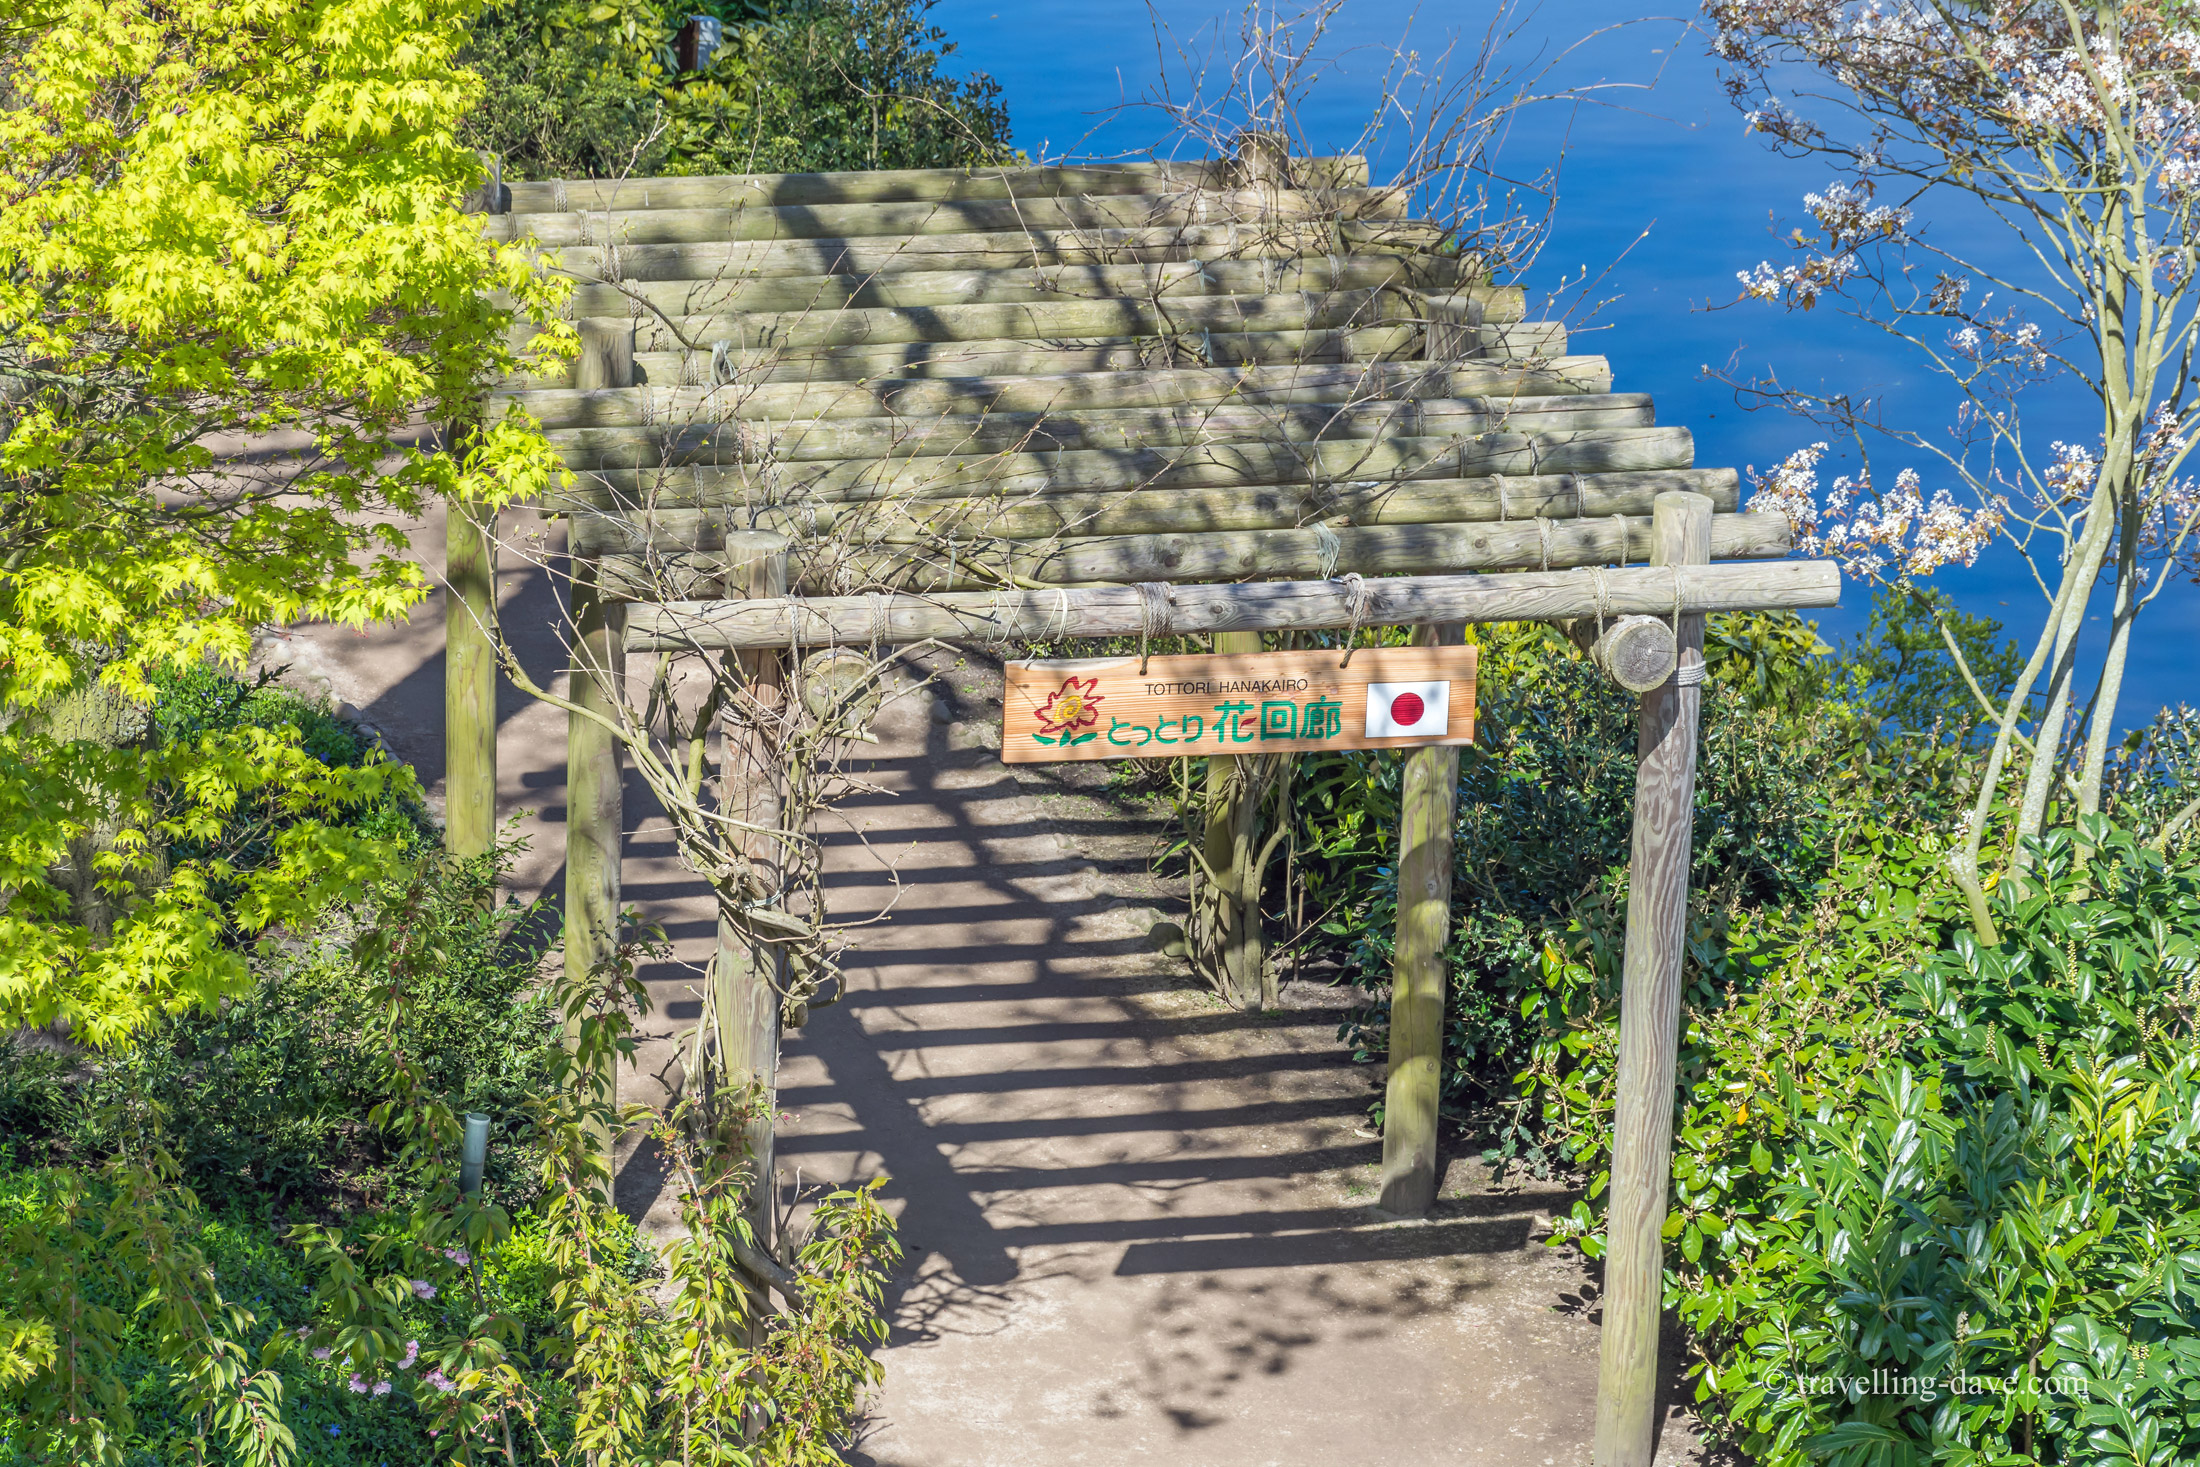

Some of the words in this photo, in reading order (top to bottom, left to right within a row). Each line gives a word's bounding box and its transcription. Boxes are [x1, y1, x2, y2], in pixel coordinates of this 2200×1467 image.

[1145, 682, 1211, 696] TOTTORI
[1219, 678, 1308, 694] HANAKAIRO
[1107, 695, 1343, 746] とっとり花回廊
